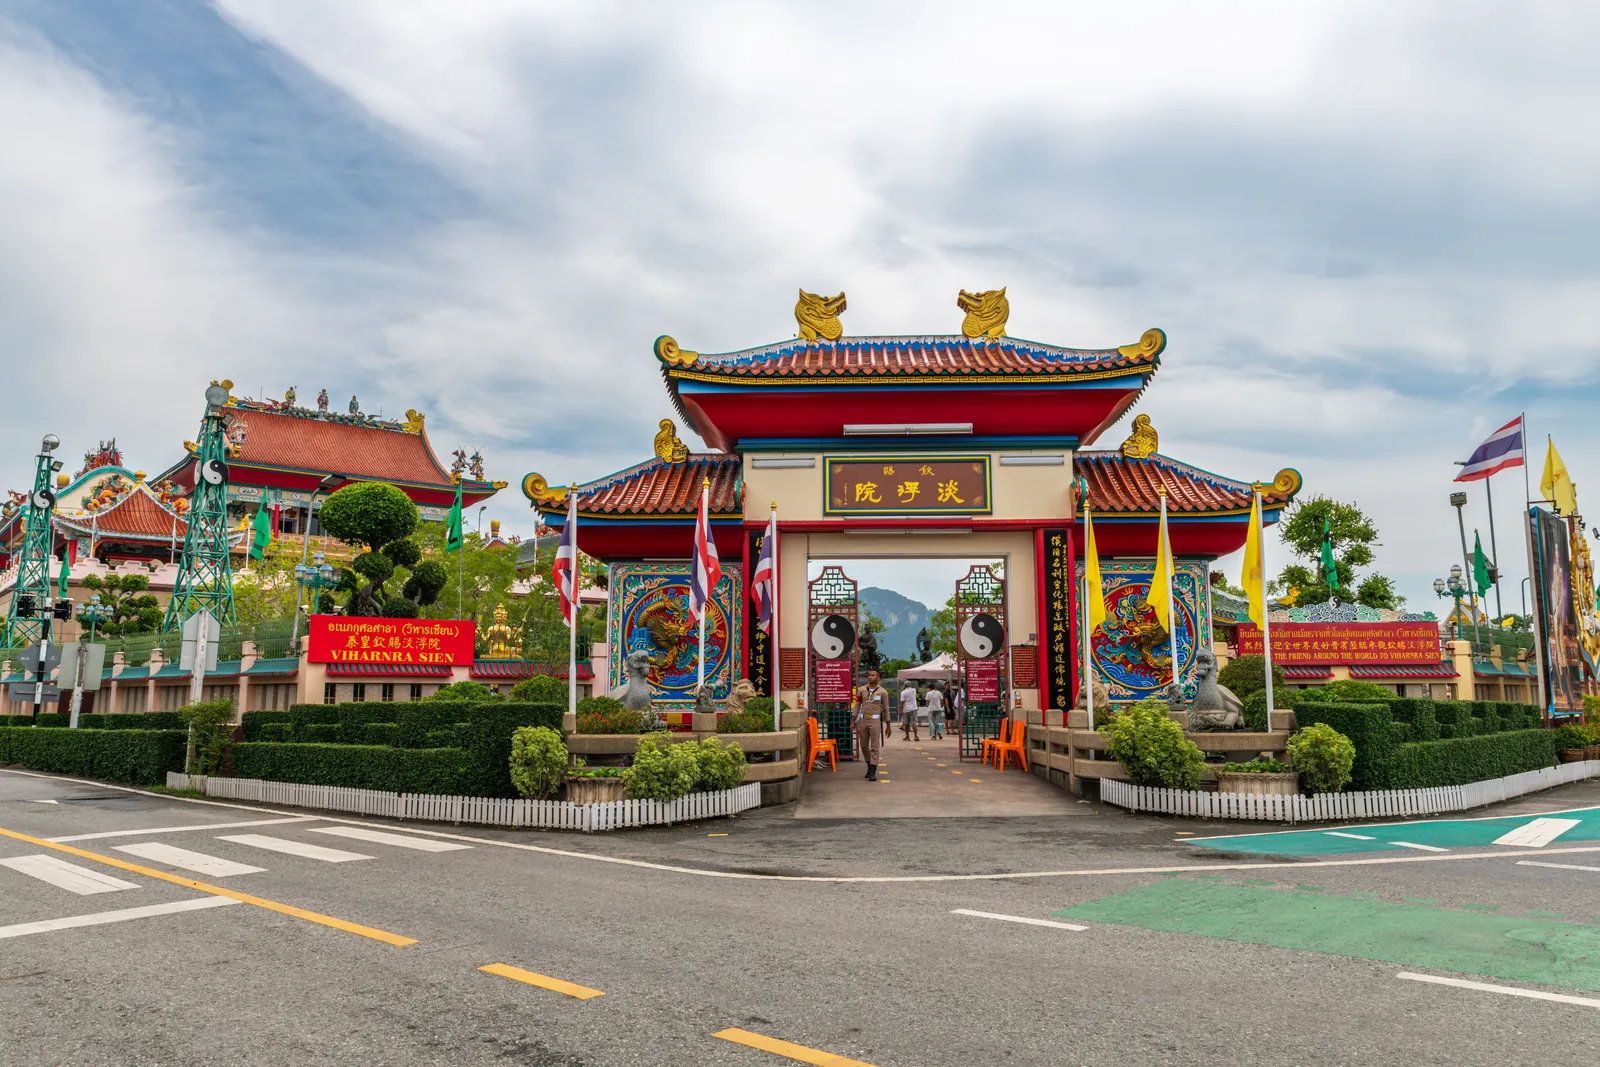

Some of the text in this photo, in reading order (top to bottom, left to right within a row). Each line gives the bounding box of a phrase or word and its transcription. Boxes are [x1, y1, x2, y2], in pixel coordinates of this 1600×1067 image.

[328, 622, 459, 638] อเนกกุศลศาลา (วิหารเซียน)
[330, 649, 455, 663] VIHARNRA SIEN
[1274, 652, 1287, 660] THE
[1288, 652, 1312, 660] FRIEND
[1313, 652, 1339, 660] AROUND
[1340, 652, 1353, 660] THE
[1354, 652, 1378, 660] WORLD
[1379, 652, 1388, 660] TO
[1389, 652, 1423, 660] VIHARNRA
[1425, 652, 1440, 660] SIEN
